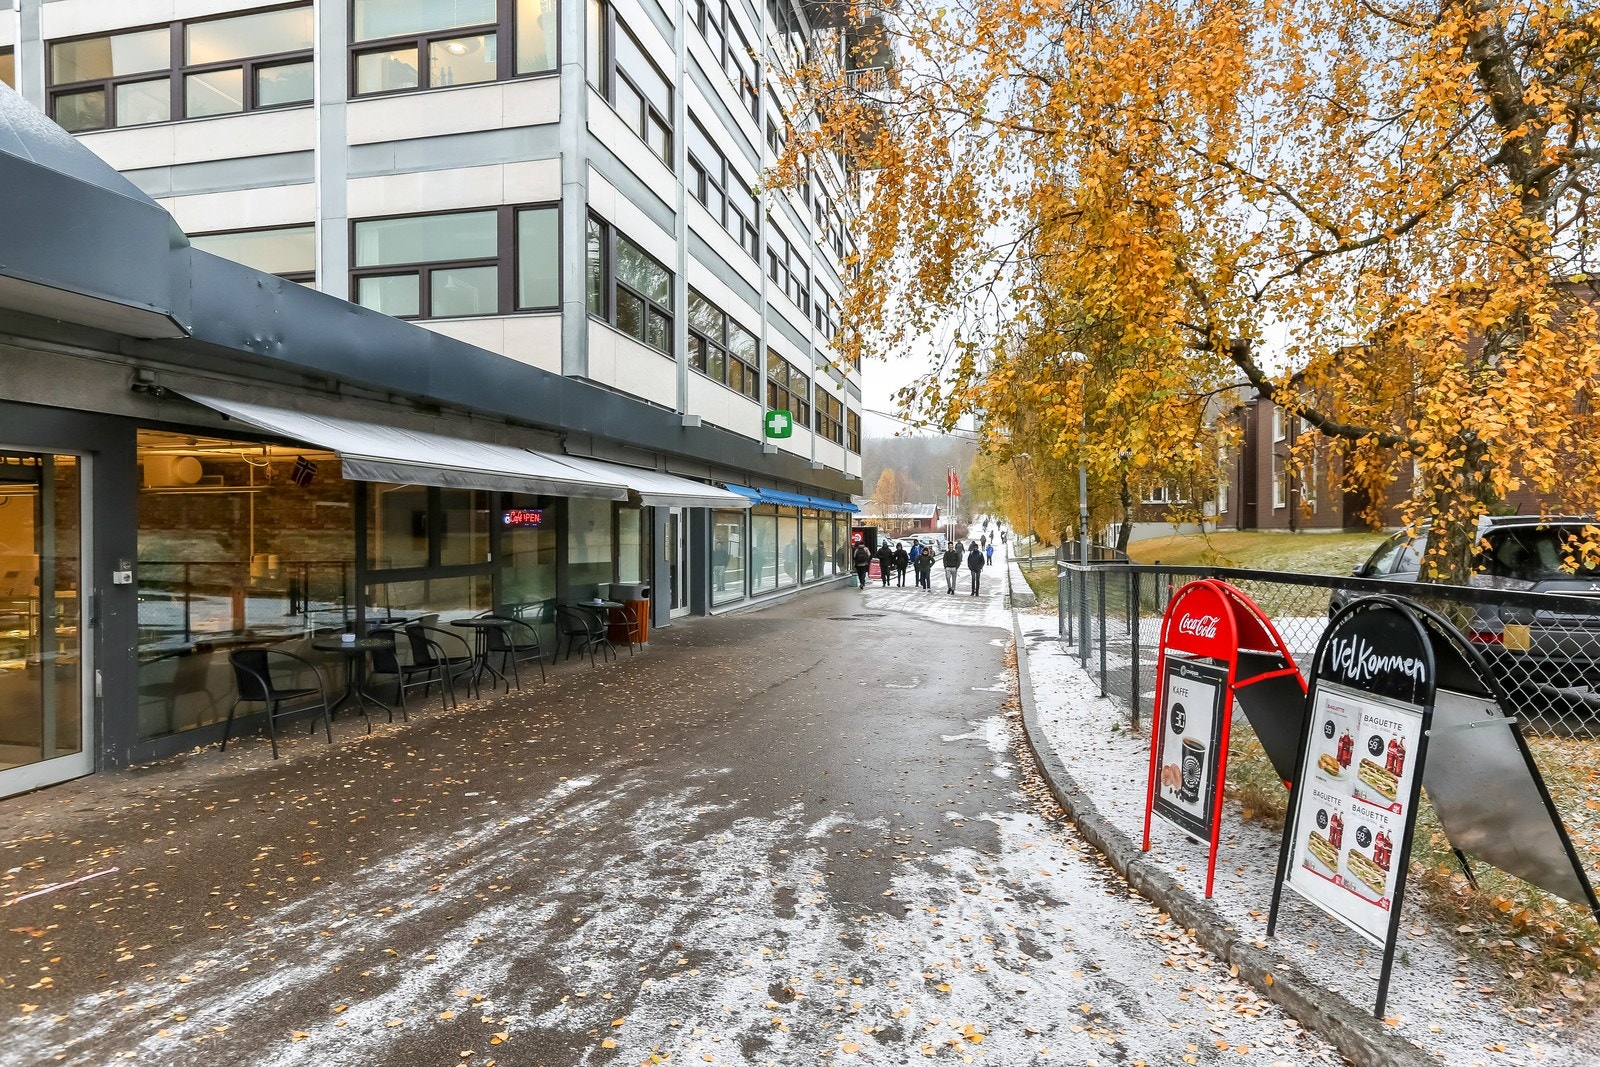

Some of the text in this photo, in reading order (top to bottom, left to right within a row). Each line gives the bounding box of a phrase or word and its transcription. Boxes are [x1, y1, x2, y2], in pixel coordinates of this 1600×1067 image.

[1178, 612, 1220, 639] Coca-Cola
[1172, 685, 1189, 698] KAFFE
[1363, 714, 1403, 731] BAGUETTE
[1312, 789, 1342, 806] BAGUETTE
[1351, 804, 1389, 824] BAGUETTE
